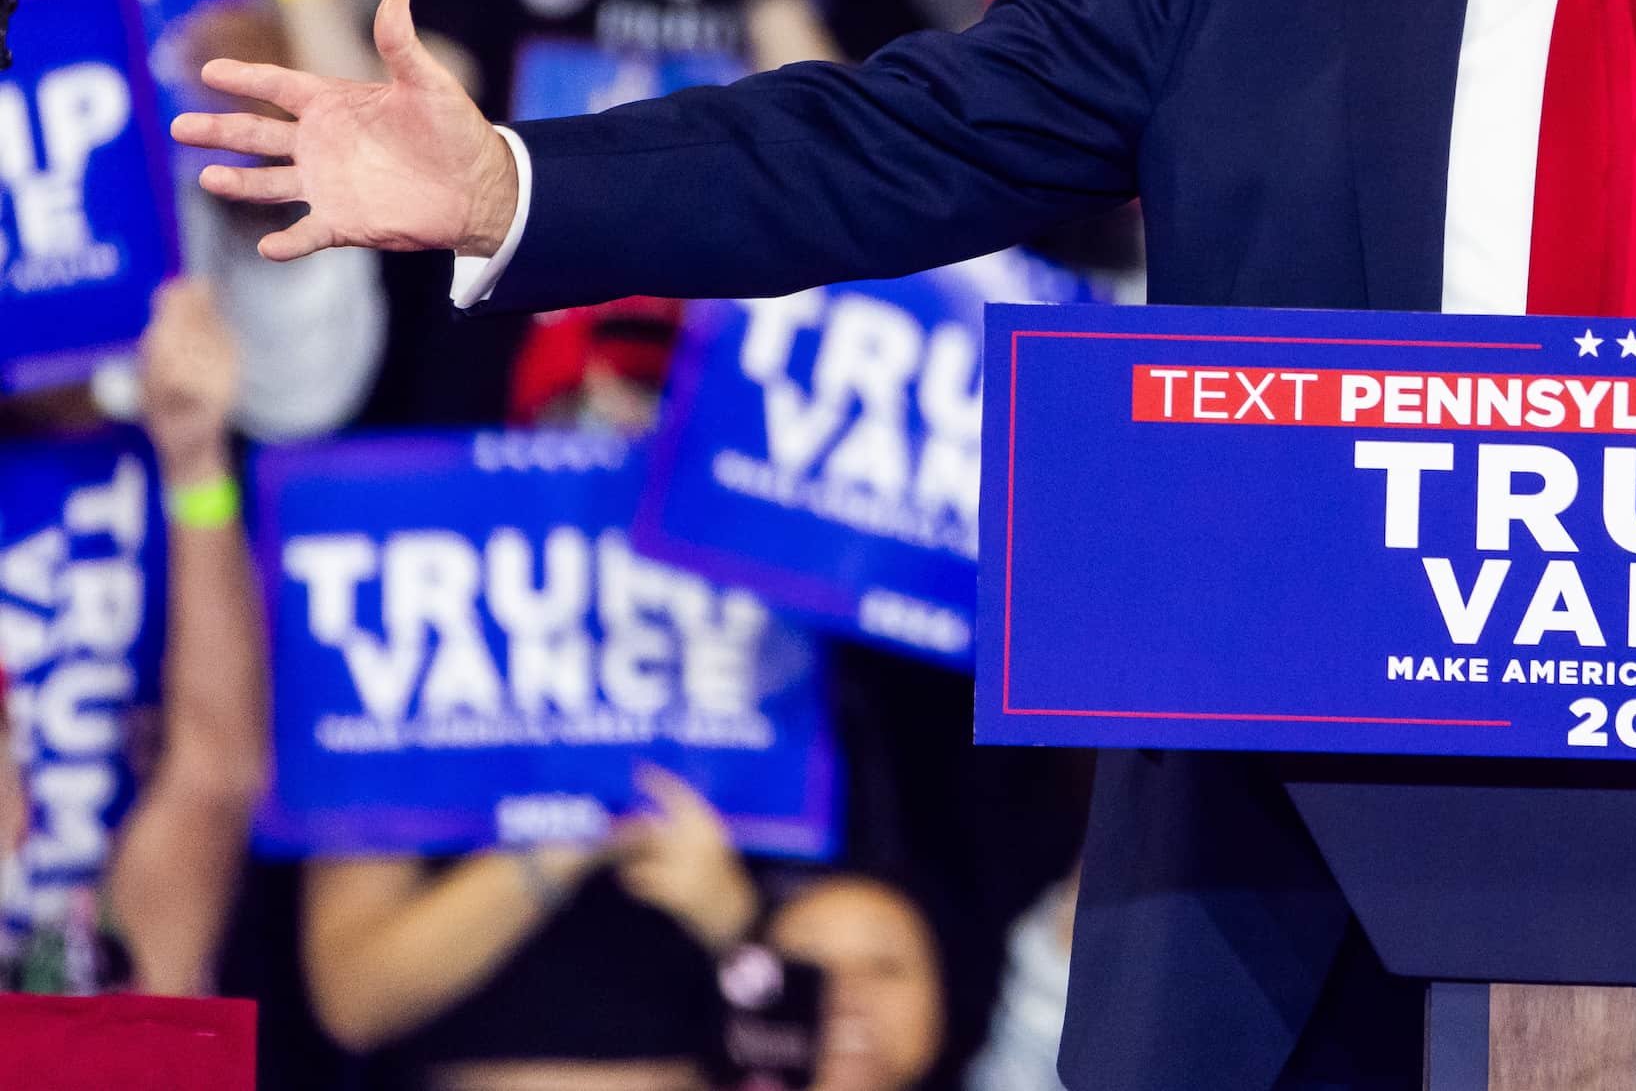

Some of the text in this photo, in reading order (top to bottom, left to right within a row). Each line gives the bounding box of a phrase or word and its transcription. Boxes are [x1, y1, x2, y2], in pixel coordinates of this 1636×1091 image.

[734, 291, 984, 438] TRU
[1149, 369, 1319, 421] TEXT
[762, 378, 983, 518] VAN
[28, 452, 150, 924] TRUM
[1387, 655, 1489, 683] MAKE
